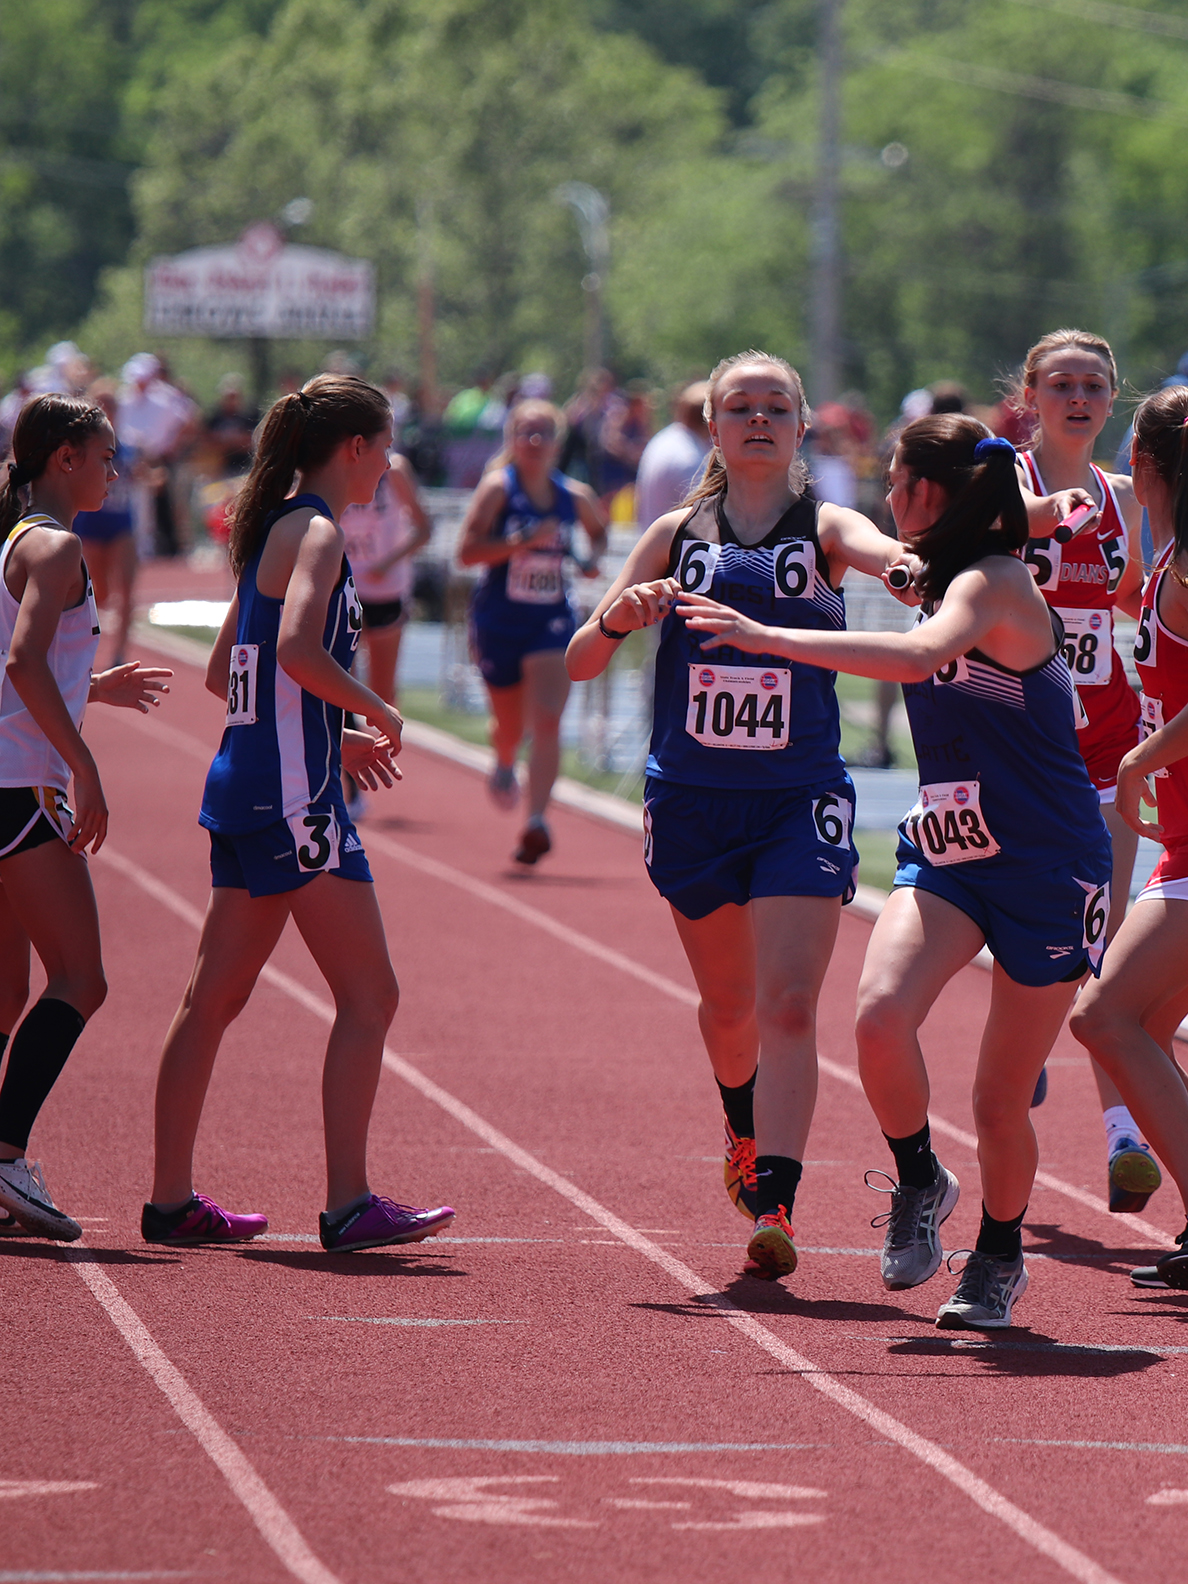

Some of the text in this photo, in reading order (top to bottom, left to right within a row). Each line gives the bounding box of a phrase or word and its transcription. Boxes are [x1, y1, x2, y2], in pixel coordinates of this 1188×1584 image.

[680, 542, 711, 593] 6
[776, 543, 808, 597] 6
[1025, 537, 1053, 586] 5
[1061, 563, 1108, 584] DIANS
[1102, 538, 1126, 591] 5
[1064, 633, 1099, 675] 58
[227, 670, 249, 715] 31
[693, 691, 785, 738] 1044
[298, 815, 330, 869] 3
[815, 797, 842, 845] 6
[910, 809, 989, 855] 1043
[1085, 887, 1105, 944] 6
